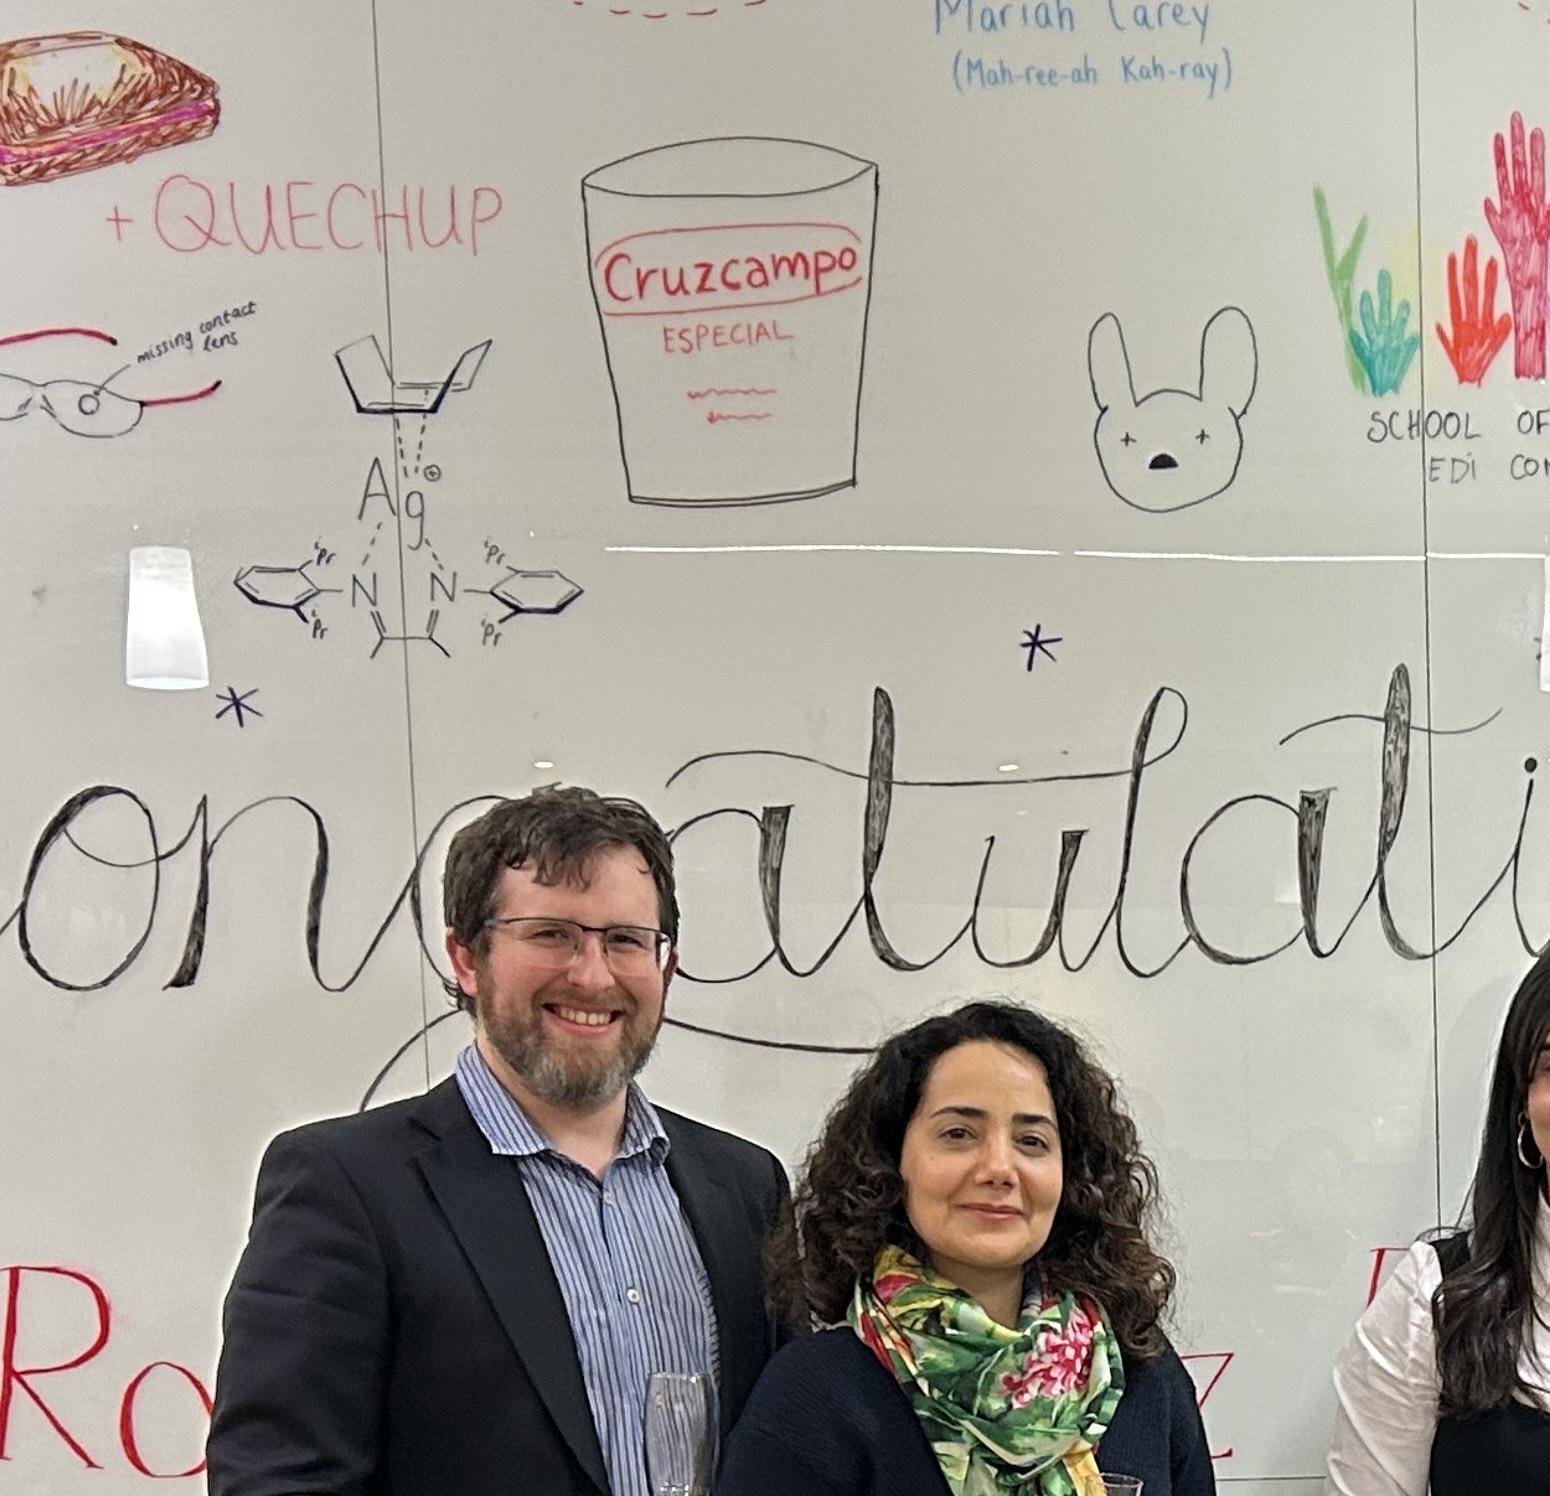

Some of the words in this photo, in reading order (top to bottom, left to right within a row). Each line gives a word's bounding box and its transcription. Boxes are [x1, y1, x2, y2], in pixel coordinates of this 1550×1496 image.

[154, 173, 503, 256] QUECHUP
[603, 246, 858, 302] Cruzcampo
[138, 331, 193, 364] missing
[200, 301, 257, 335] contact
[203, 331, 239, 352] lens
[662, 319, 794, 354] ESPECIAL
[1366, 407, 1482, 443] SCHOOL
[358, 457, 426, 551] Ag
[351, 572, 377, 607] N
[430, 571, 457, 602] N
[0, 1264, 213, 1478] Ro
